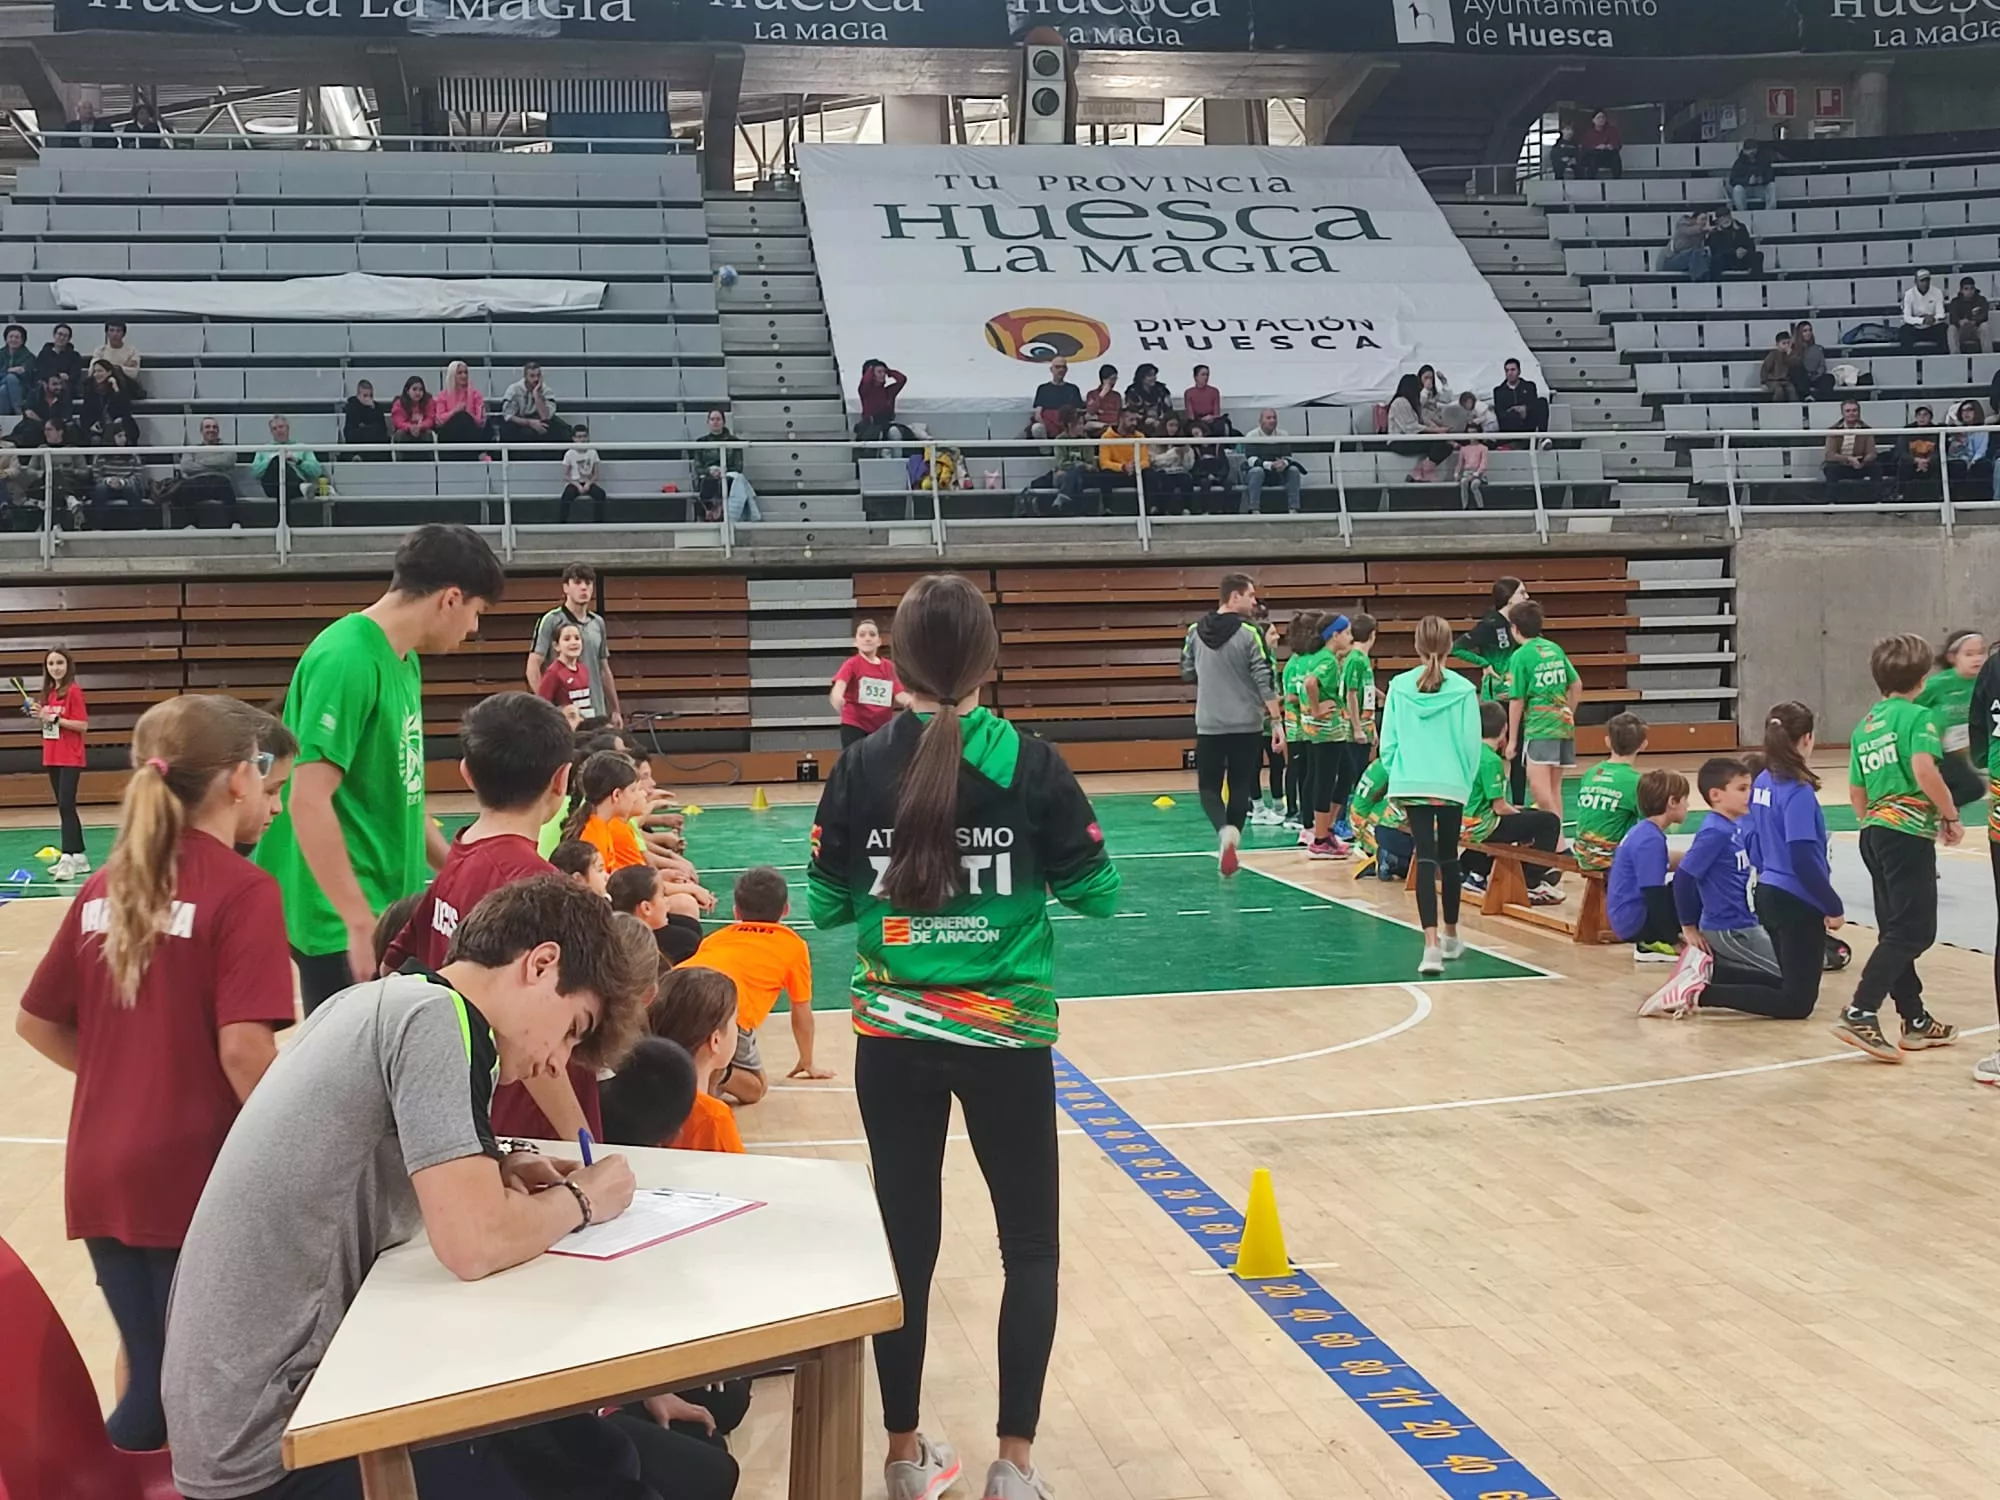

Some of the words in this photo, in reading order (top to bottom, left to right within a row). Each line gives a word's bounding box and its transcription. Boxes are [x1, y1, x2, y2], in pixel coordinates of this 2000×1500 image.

[1464, 0, 1657, 20] Ayuntamiento
[1466, 21, 1499, 45] de
[1507, 22, 1614, 47] Huesca
[874, 199, 1392, 242] Huesca
[1133, 315, 1375, 333] DIPUTACIÓN
[1140, 335, 1382, 351] HUESCA
[911, 916, 989, 930] GOBIERNO
[911, 930, 932, 944] DE
[1260, 1284, 1308, 1298] 20
[1289, 1308, 1333, 1322] 40
[1312, 1332, 1361, 1348] 60
[1341, 1359, 1392, 1376] 80
[1367, 1387, 1433, 1409] 11
[1401, 1420, 1461, 1439] 20
[1443, 1454, 1498, 1474] 40
